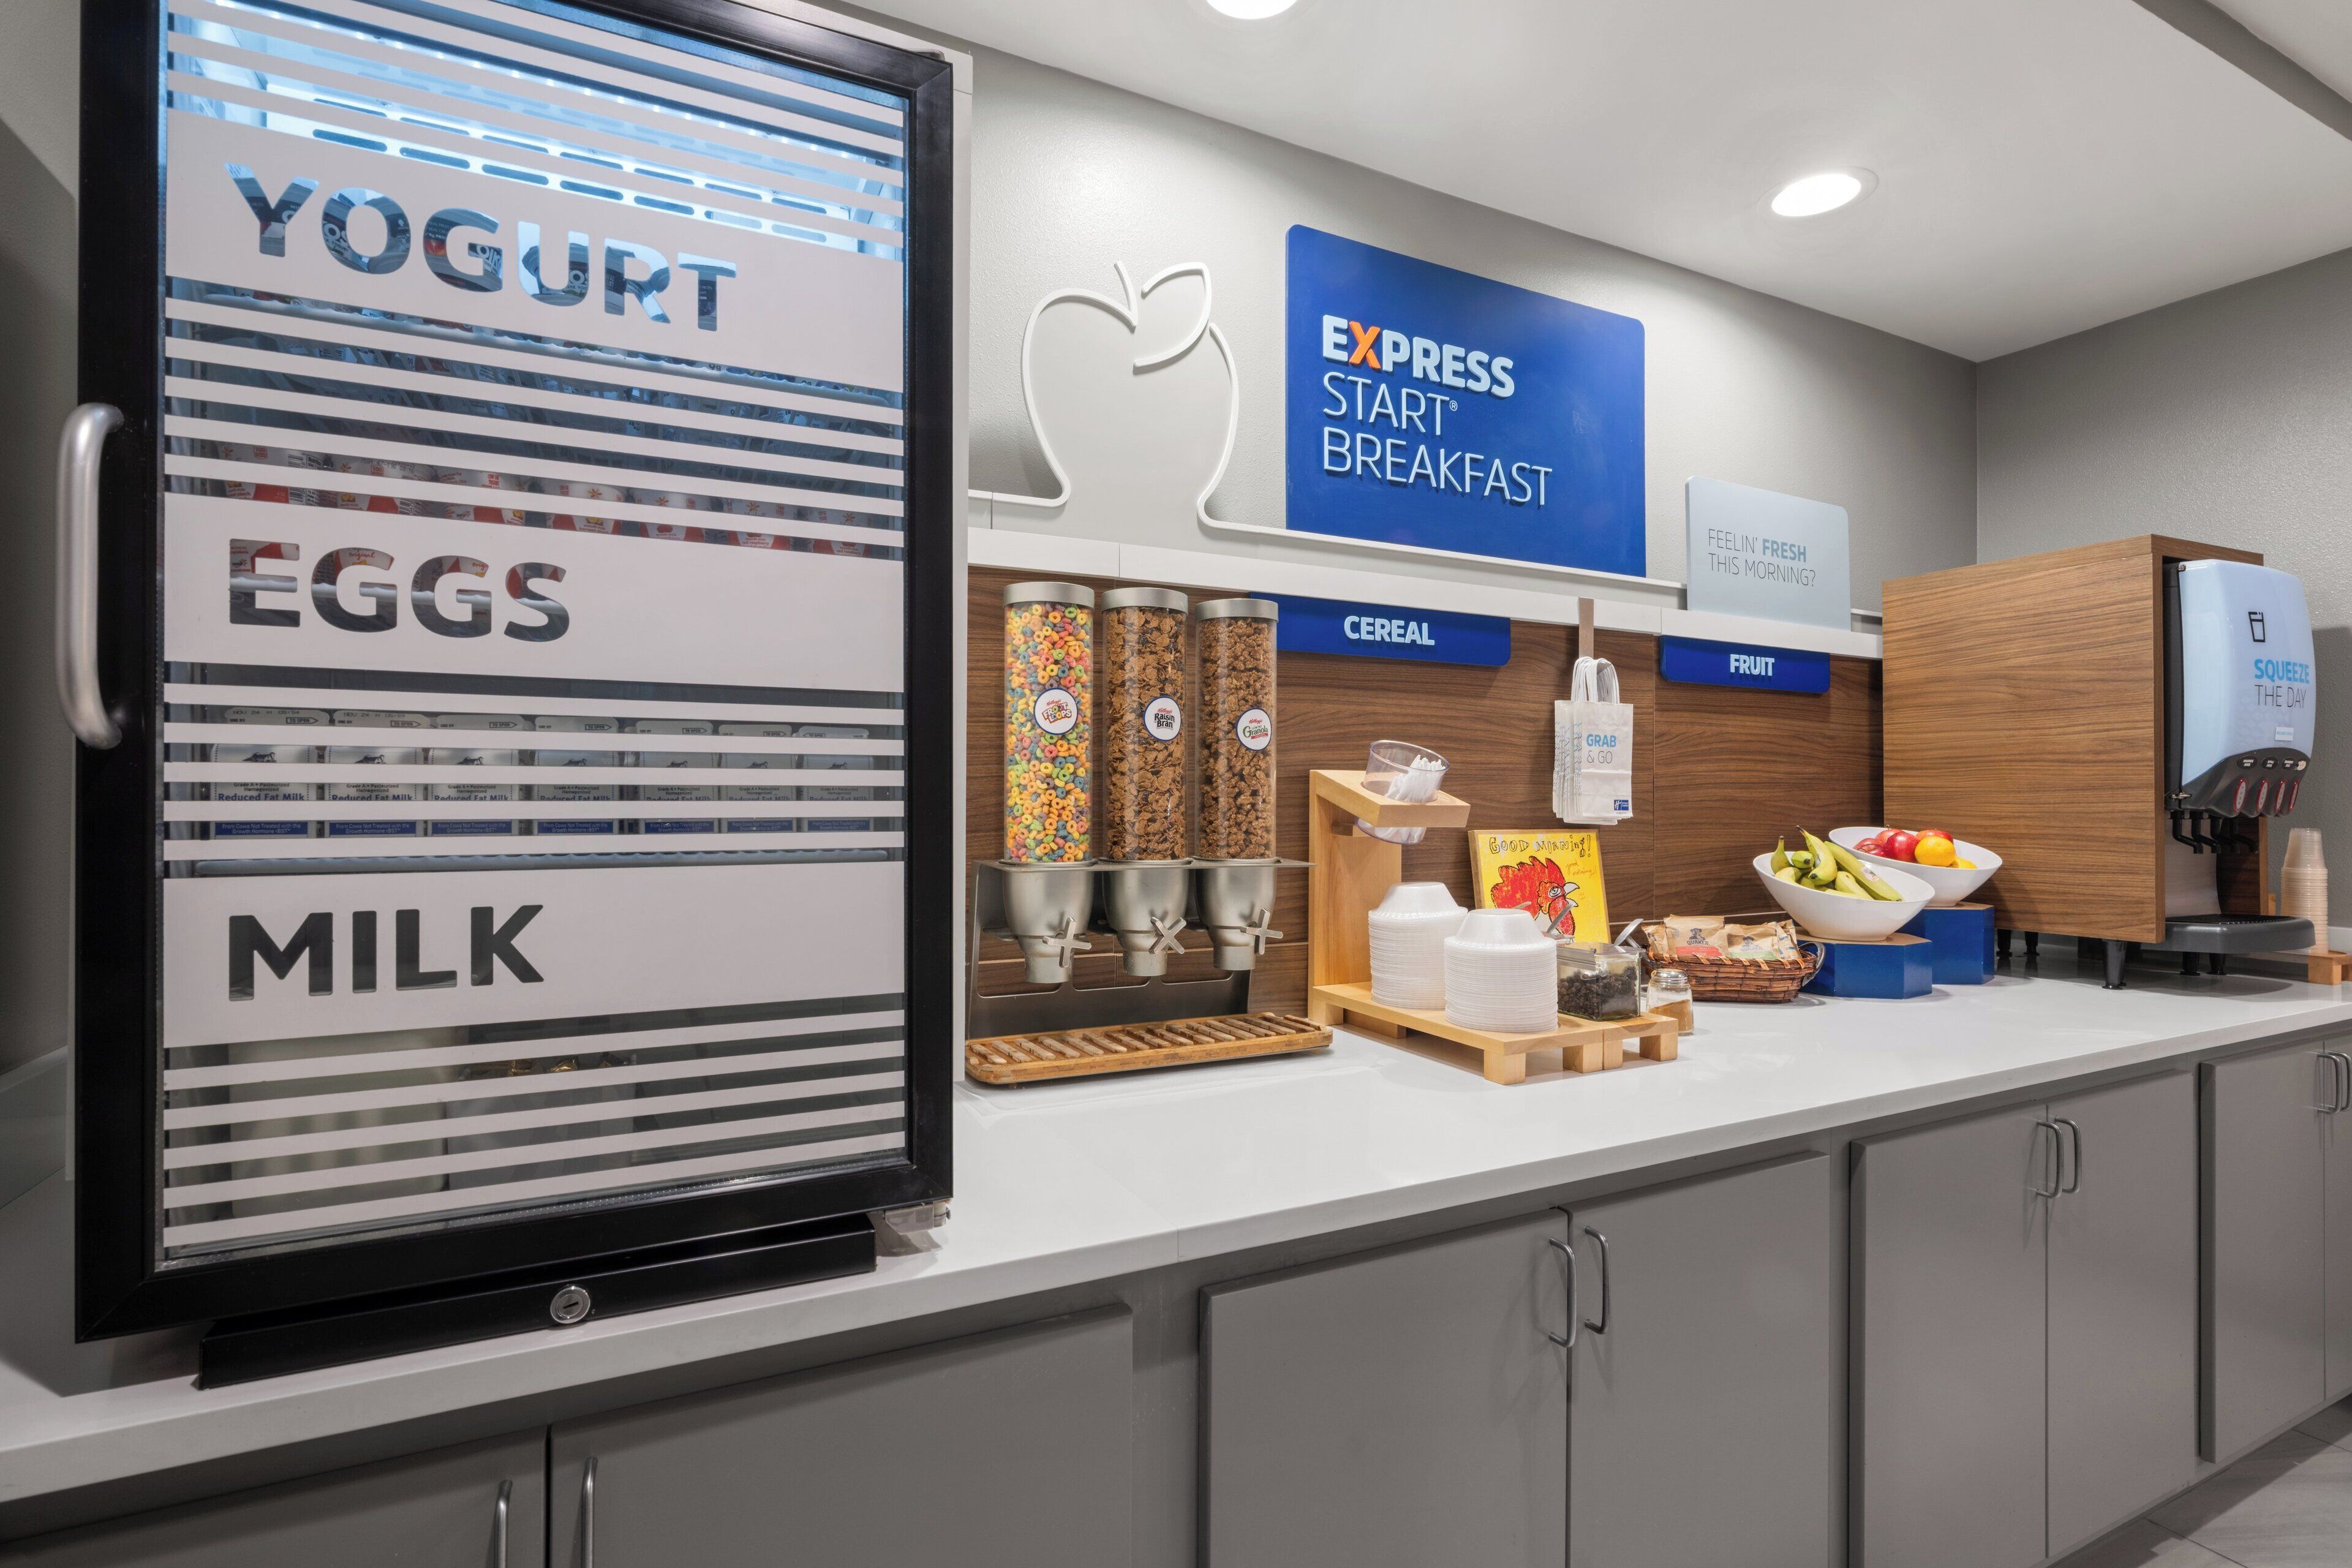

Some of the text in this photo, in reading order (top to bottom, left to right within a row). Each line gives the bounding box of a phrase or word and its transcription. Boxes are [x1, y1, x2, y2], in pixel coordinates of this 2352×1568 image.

[224, 162, 737, 332] YOGURT
[1323, 314, 1515, 398] EXPRESS
[1323, 426, 1553, 505] BREAKFAST
[349, 551, 375, 560] original
[1708, 528, 1807, 563] FEELIN' FRESH
[1708, 552, 1816, 587] THIS MORNING?
[229, 538, 570, 643] EGGS
[1344, 616, 1435, 646] CEREAL
[1730, 654, 1775, 677] FRUIT
[2253, 658, 2310, 684] SQUEEZE
[2254, 684, 2307, 709] THE DAY
[1048, 709, 1072, 724] LOOPS
[1154, 713, 1175, 723] Raisin
[1156, 720, 1173, 729] Bran
[1243, 725, 1268, 738] Granola
[1586, 734, 1617, 748] GRAB
[1586, 750, 1613, 764] & GO
[1489, 837, 1529, 854] GOOD
[228, 904, 545, 1001] MILK
